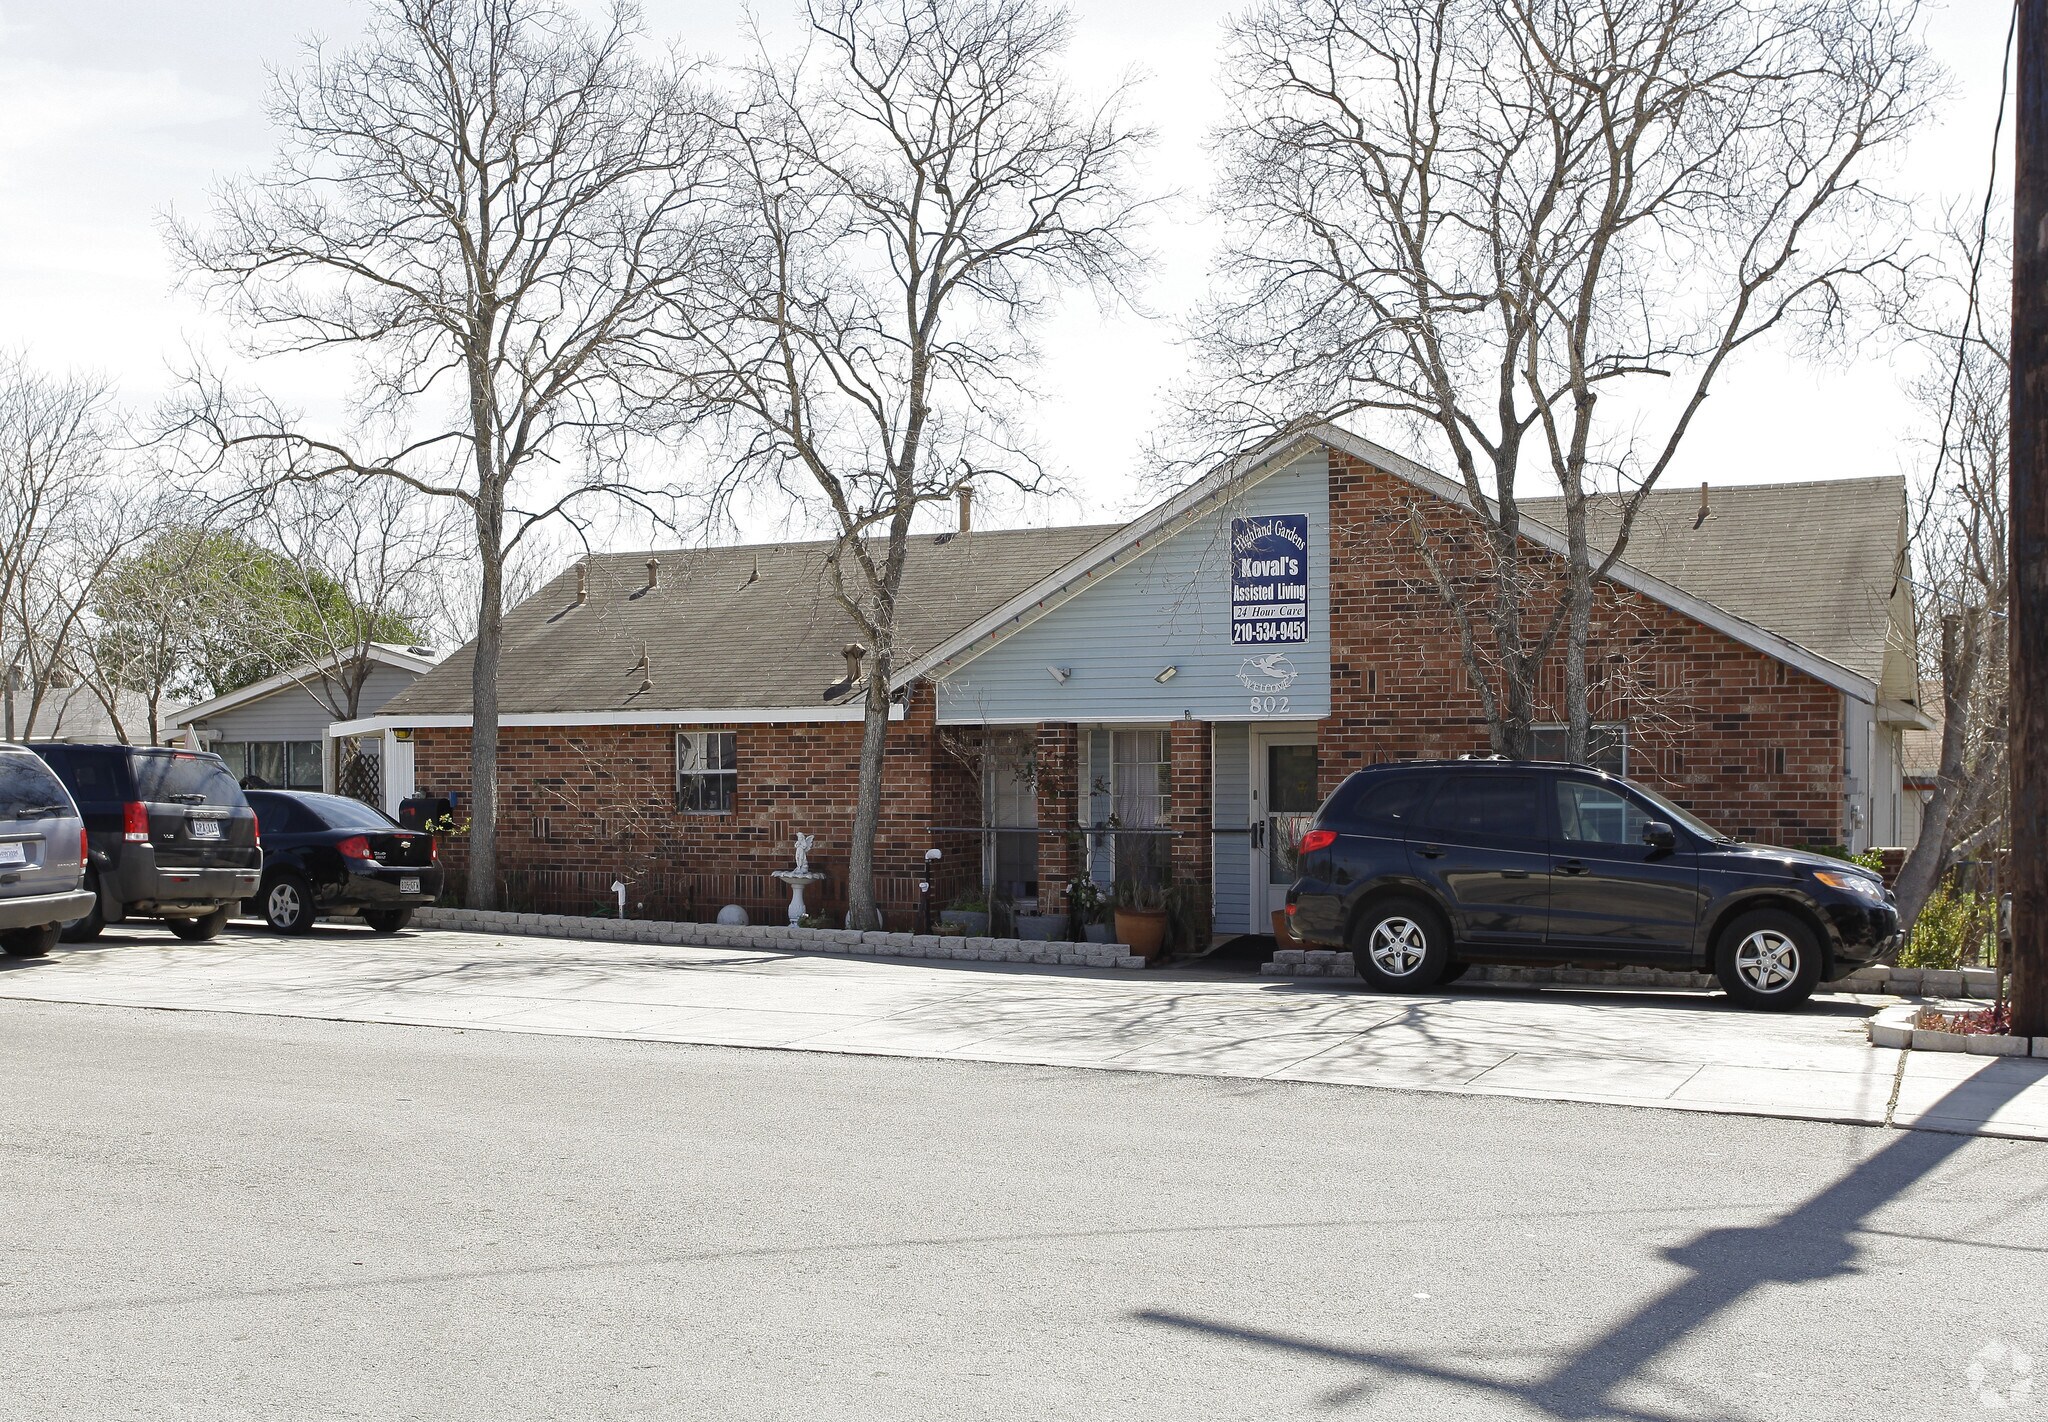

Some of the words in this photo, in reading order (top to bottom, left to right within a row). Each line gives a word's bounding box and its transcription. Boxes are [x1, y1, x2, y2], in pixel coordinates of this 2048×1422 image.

[1233, 520, 1272, 553] Highland
[1275, 520, 1306, 551] Gardens
[1241, 556, 1299, 578] Koval's
[1233, 583, 1274, 602] Assisted
[1277, 582, 1306, 601] Living
[1237, 607, 1247, 618] 24
[1252, 606, 1276, 617] Hour
[1279, 605, 1303, 616] Care
[1234, 621, 1306, 642] 210-534-9451
[1244, 678, 1291, 693] WELCOME
[1249, 696, 1291, 714] 802
